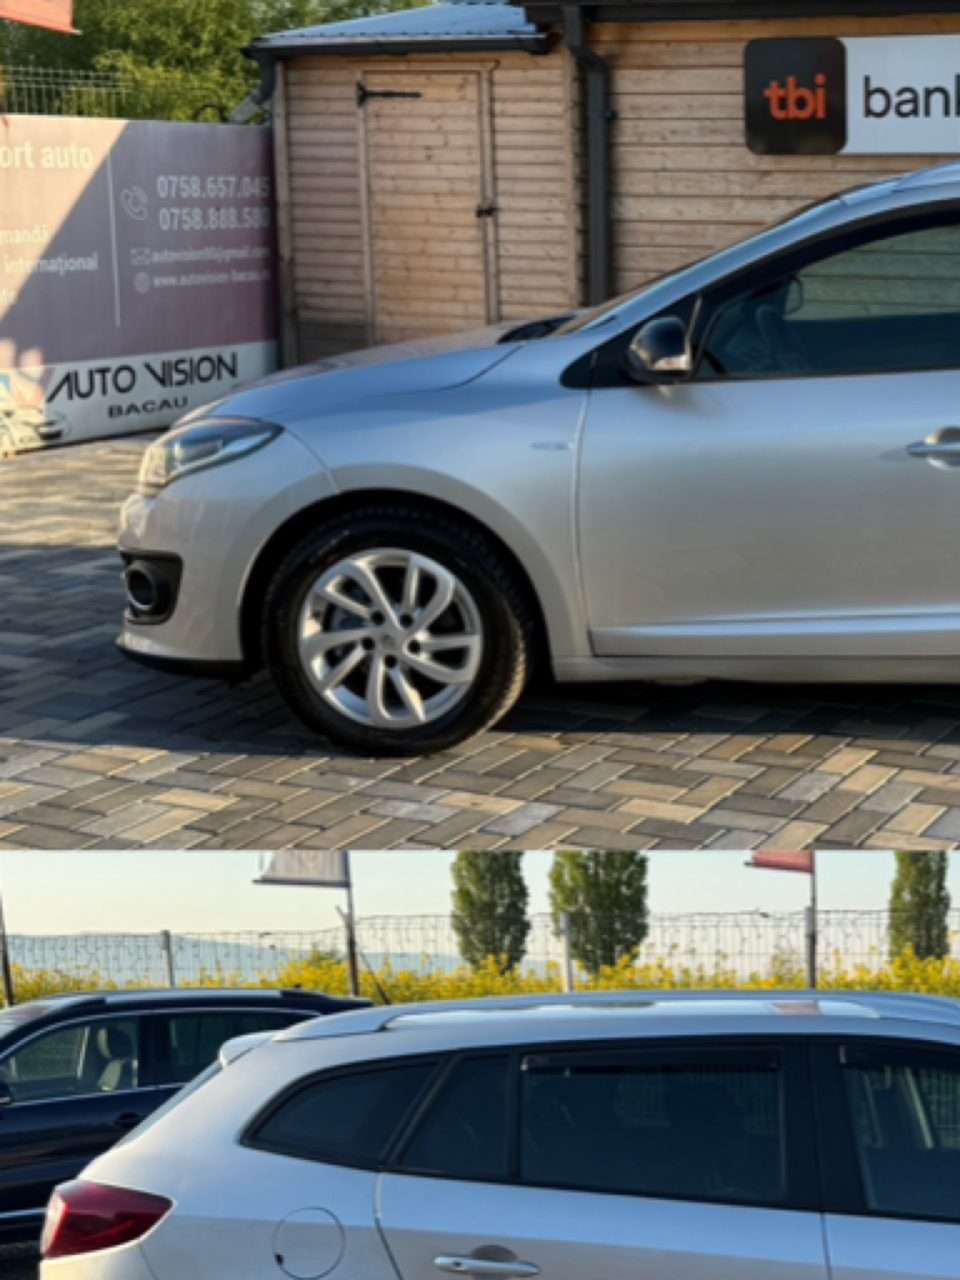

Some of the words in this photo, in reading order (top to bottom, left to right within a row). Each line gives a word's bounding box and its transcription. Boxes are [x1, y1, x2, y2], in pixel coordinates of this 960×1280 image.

[763, 73, 829, 120] tbi
[41, 143, 94, 169] auto
[46, 364, 136, 403] AUTO
[143, 352, 238, 388] VISION
[108, 396, 189, 418] BACAU
